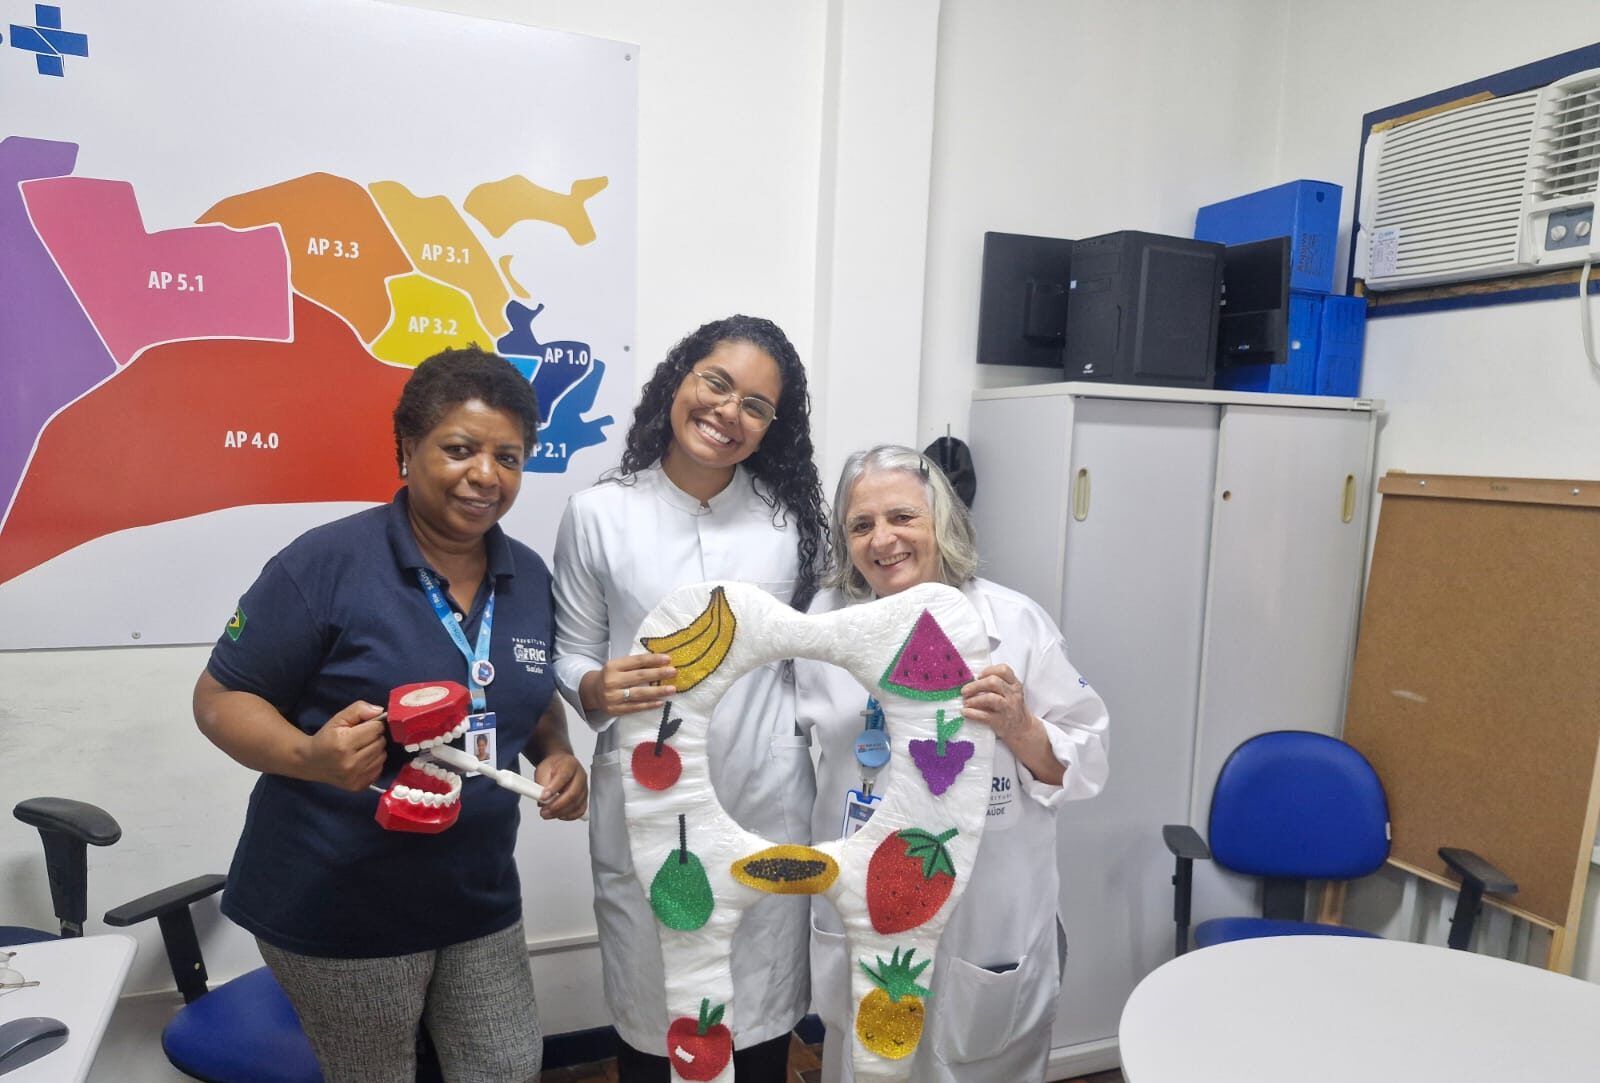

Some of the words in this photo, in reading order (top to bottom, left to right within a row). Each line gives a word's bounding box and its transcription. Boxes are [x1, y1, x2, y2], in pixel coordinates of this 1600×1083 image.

[307, 237, 330, 255] AP
[333, 240, 360, 259] 3.3
[421, 243, 443, 261] AP
[446, 246, 470, 264] 3.1
[147, 270, 173, 289] AP
[177, 273, 204, 292] 5.1
[408, 315, 430, 333] AP
[433, 319, 458, 336] 3.2
[544, 347, 564, 364] AP
[566, 349, 589, 366] 1.0
[224, 430, 248, 448] AP
[251, 432, 279, 449] 4.0
[530, 442, 543, 458] P
[545, 442, 567, 459] 2.1
[991, 776, 1011, 792] Rio
[986, 806, 1006, 816] AÚDE
